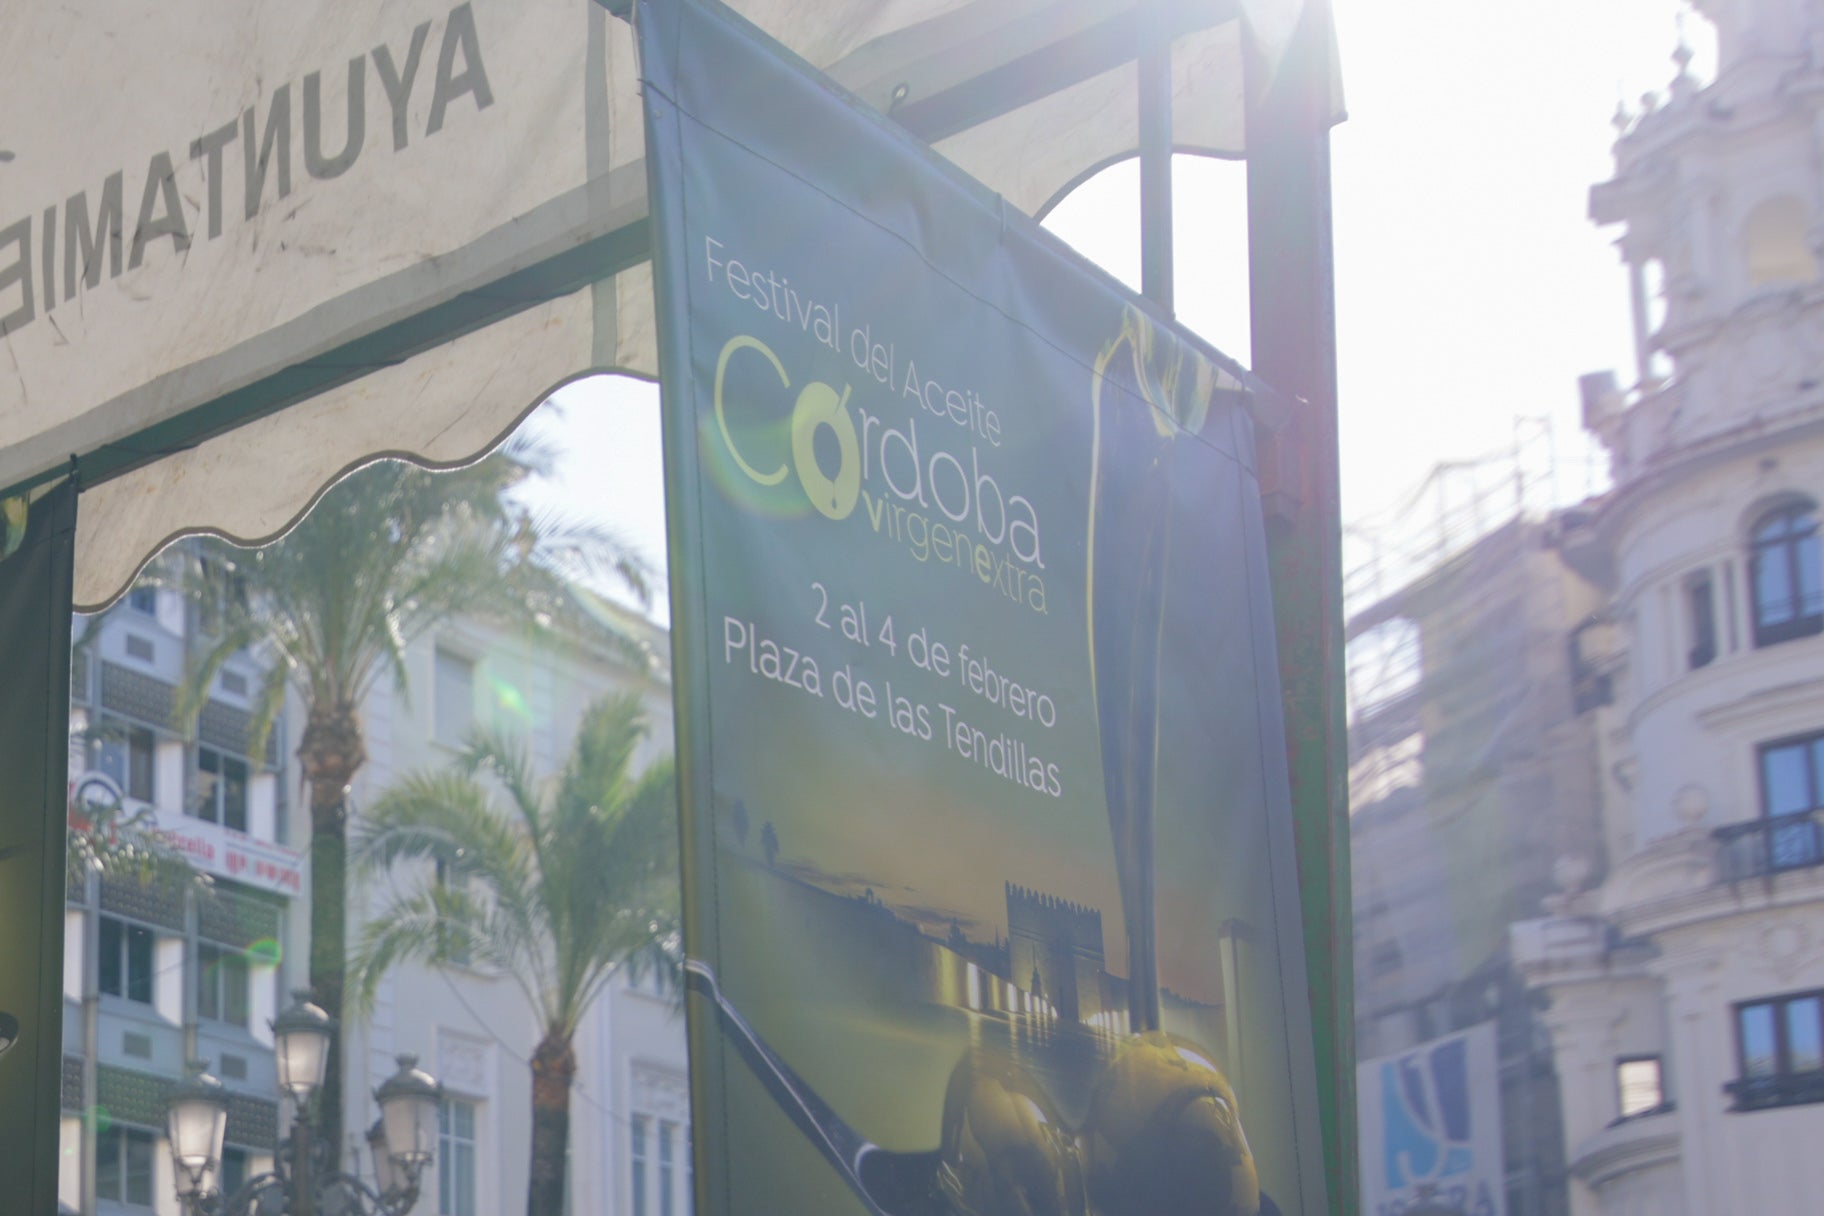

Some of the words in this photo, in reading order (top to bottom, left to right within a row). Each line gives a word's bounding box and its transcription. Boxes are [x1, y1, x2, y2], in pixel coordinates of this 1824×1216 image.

[704, 236, 842, 353] Festival
[850, 325, 896, 392] del
[902, 360, 1003, 447] Aceite
[723, 615, 824, 699] Plaza
[832, 664, 877, 718] de
[886, 682, 933, 743] las
[938, 702, 1063, 798] Tendillas
[811, 581, 832, 630] 2
[840, 601, 869, 647] al
[878, 615, 897, 657] 4
[907, 627, 951, 678] de
[958, 644, 1056, 729] febrero
